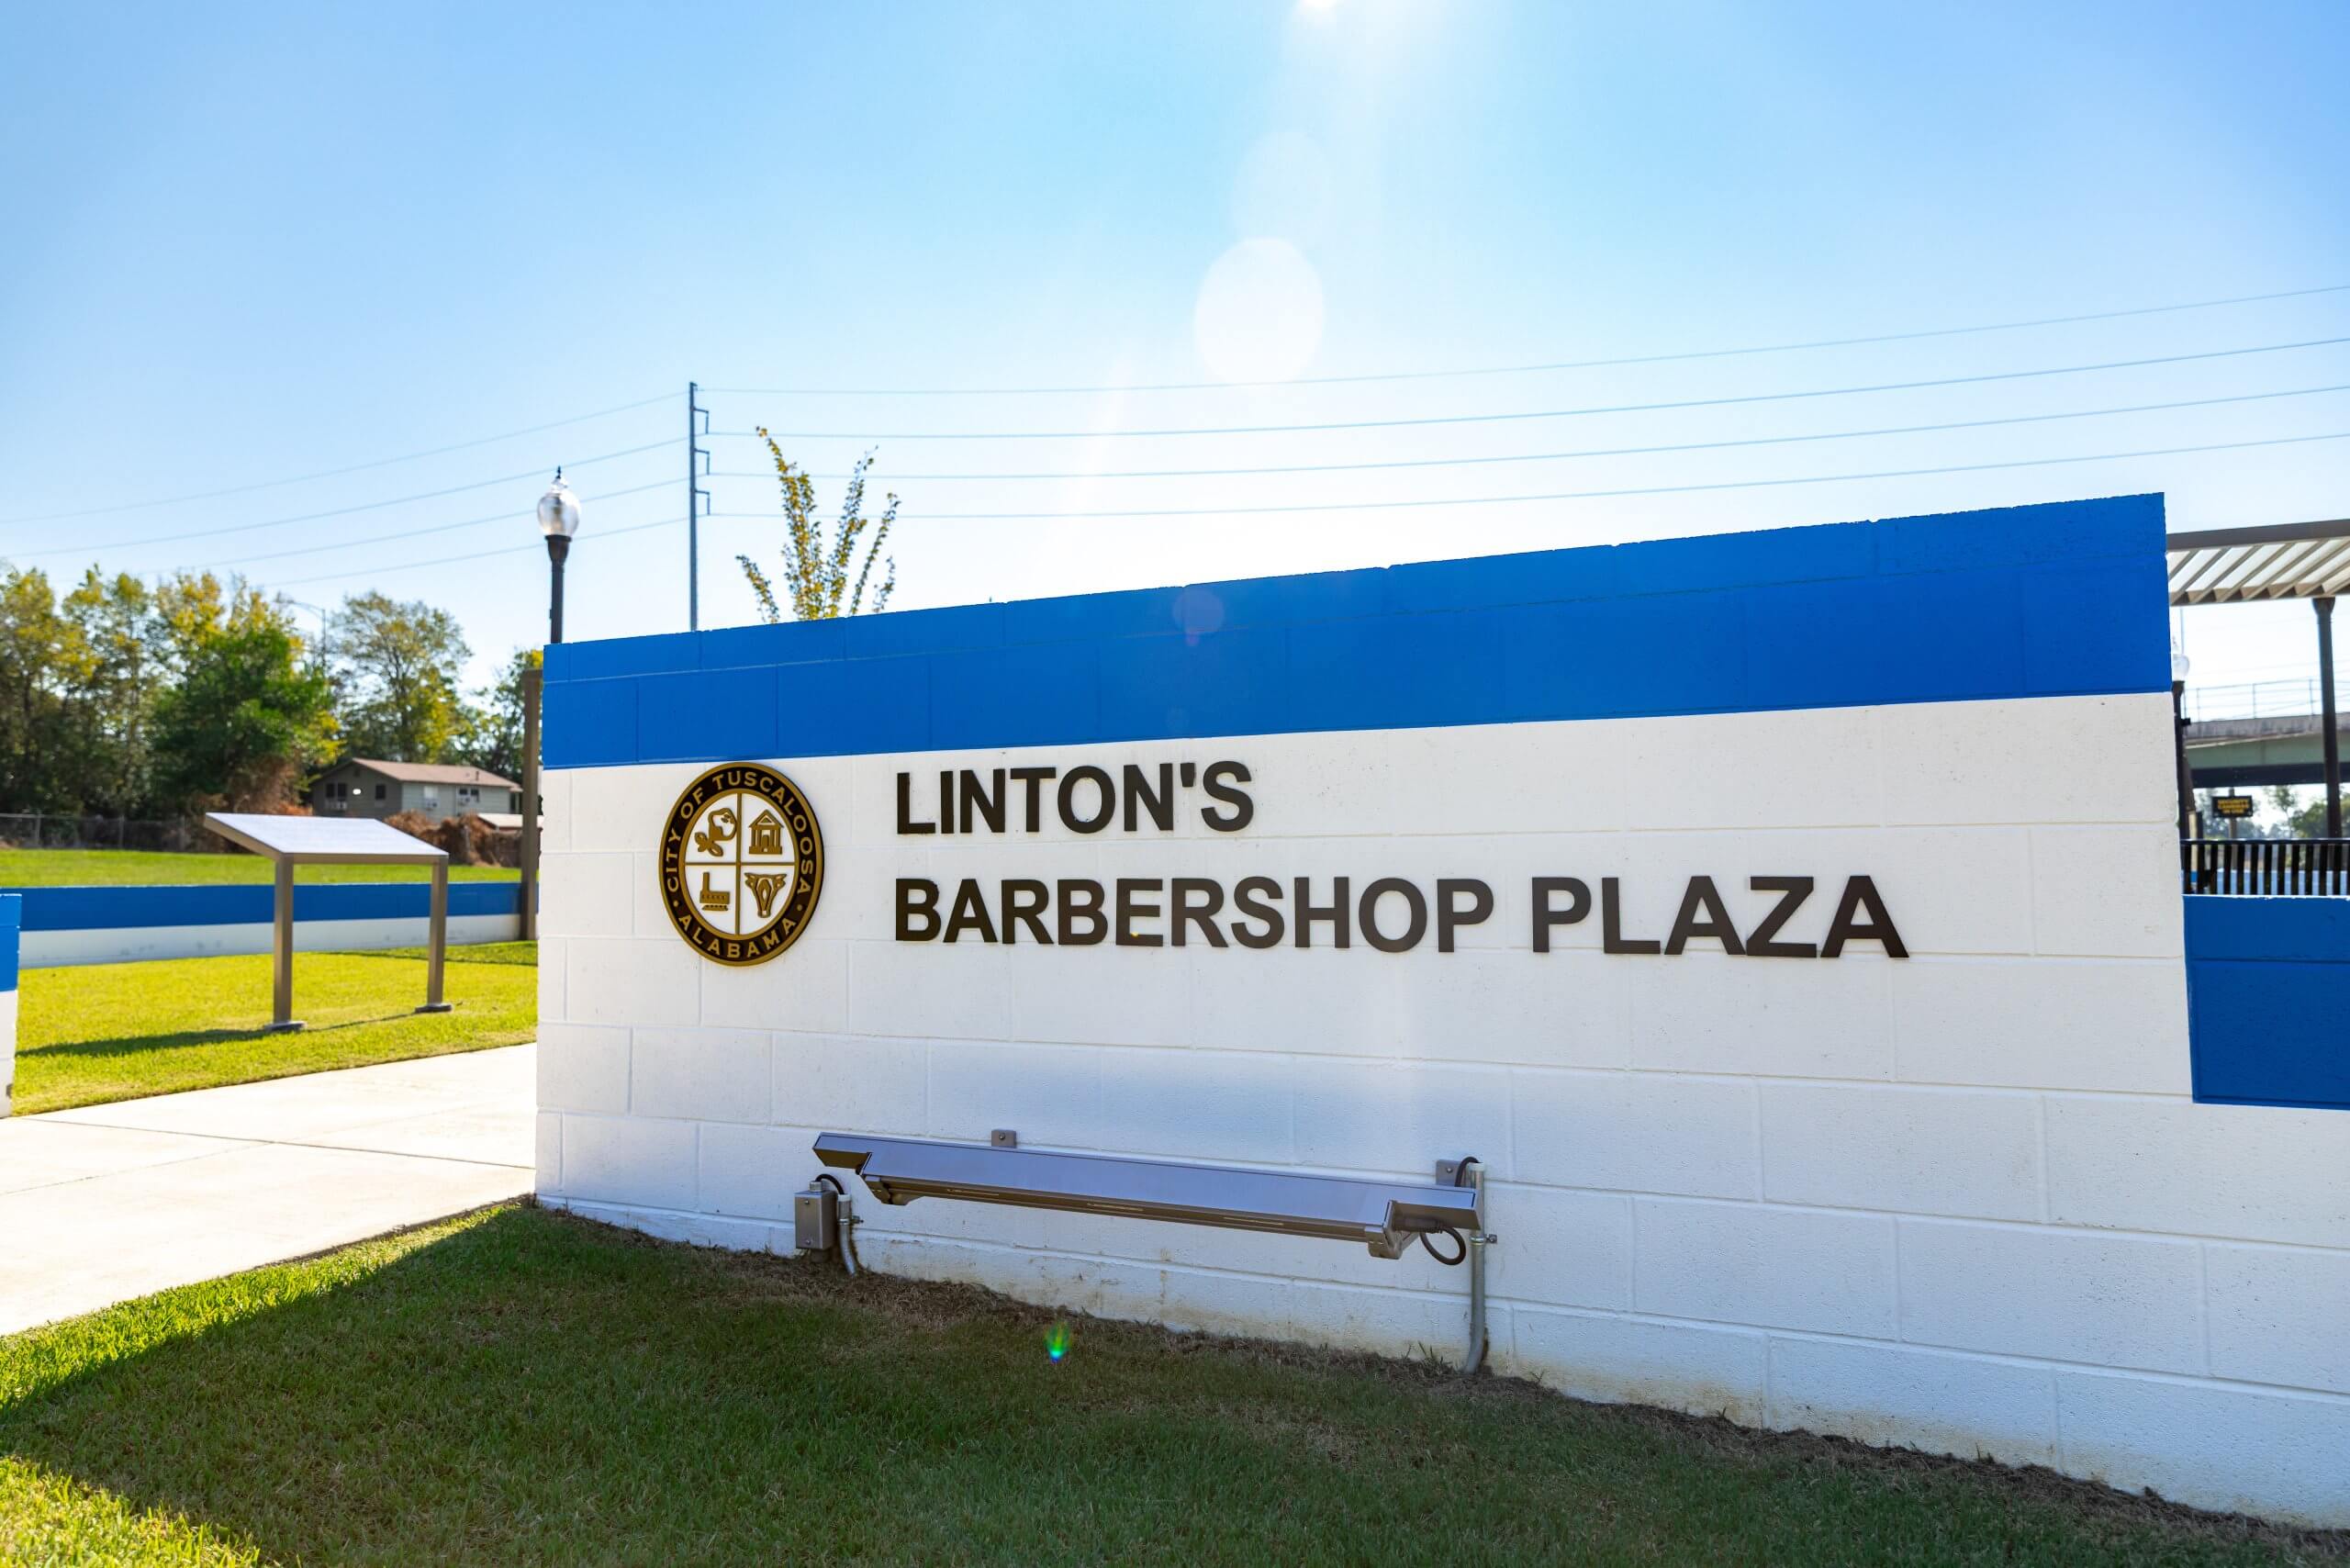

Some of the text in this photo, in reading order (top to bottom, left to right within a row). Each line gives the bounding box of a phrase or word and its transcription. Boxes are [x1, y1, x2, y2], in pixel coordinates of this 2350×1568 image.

[666, 770, 813, 894] CITY OF TUSCALOOSA
[896, 761, 1255, 834] LINTON'S
[678, 914, 797, 958] ALABAMA
[895, 875, 1910, 958] BARBERSHOP PLAZA
